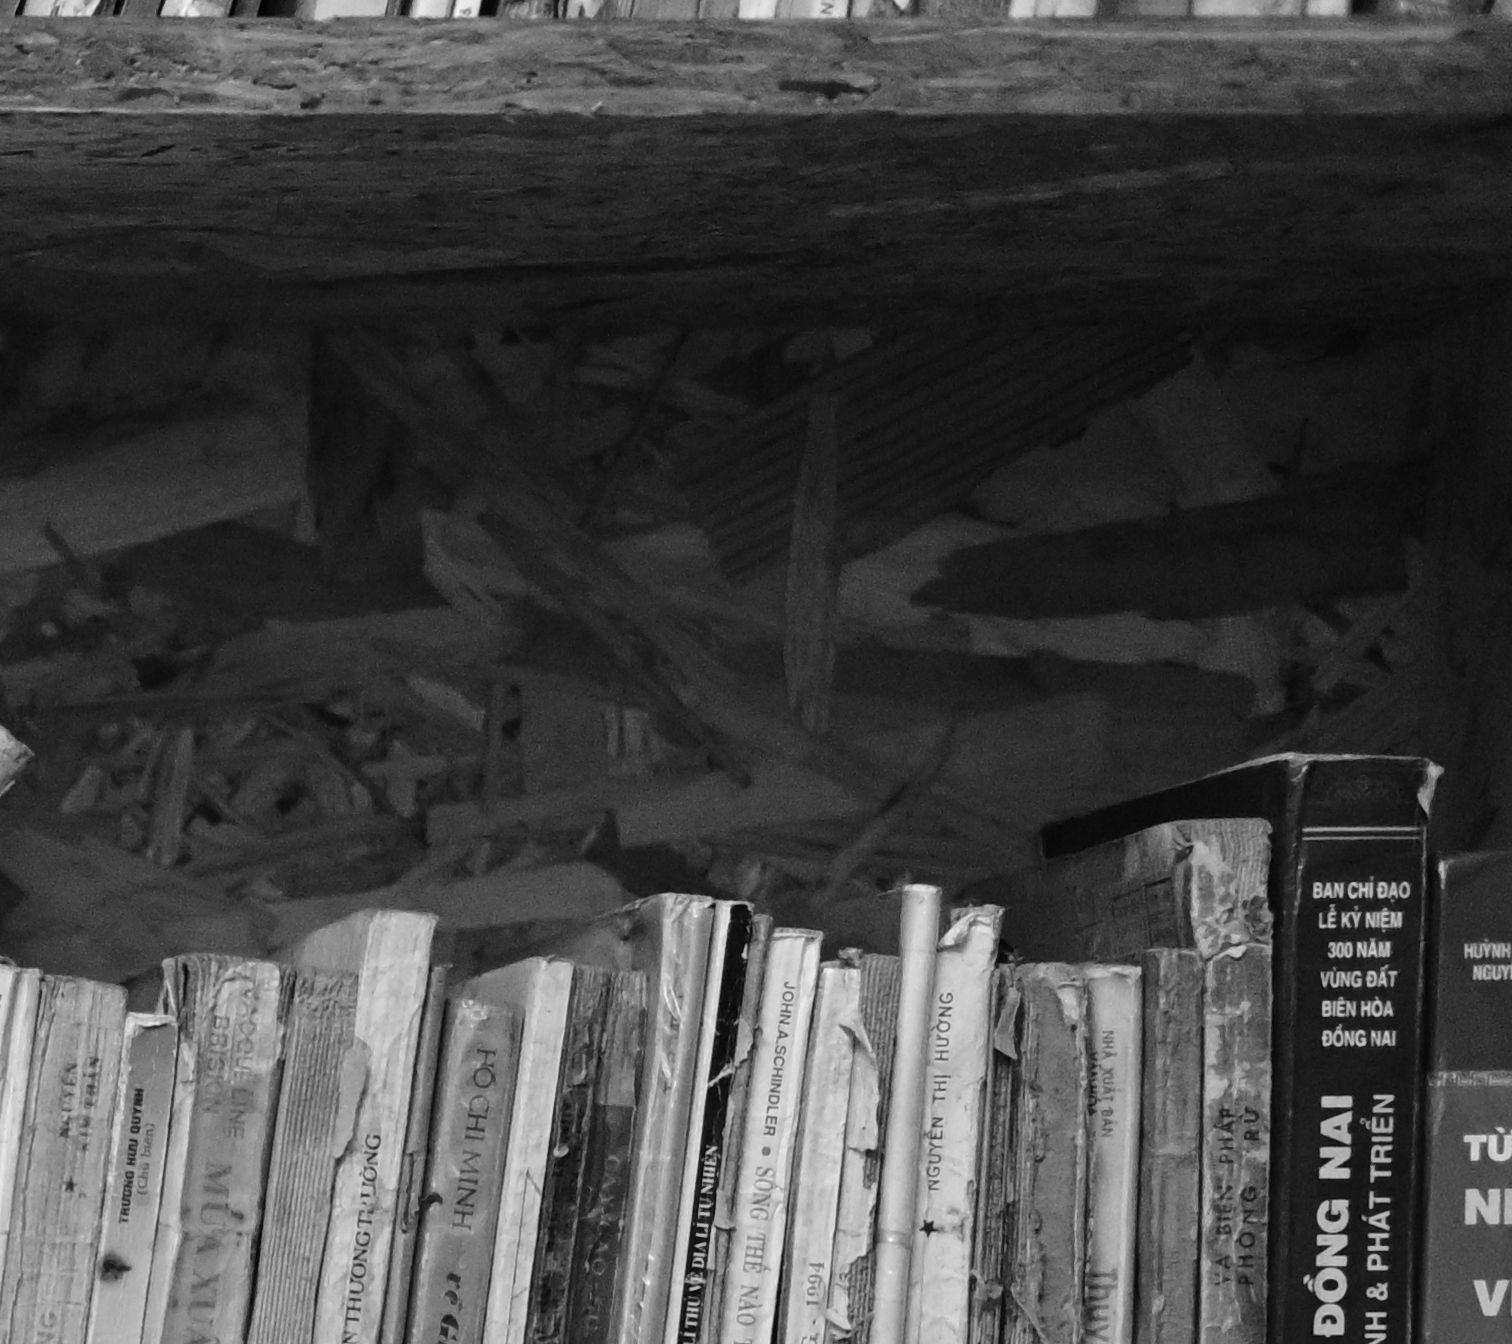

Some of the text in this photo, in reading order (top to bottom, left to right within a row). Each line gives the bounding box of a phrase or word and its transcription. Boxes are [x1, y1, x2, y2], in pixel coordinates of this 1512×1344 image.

[1313, 877, 1411, 903] BAN CHỈ ĐẠO
[1318, 904, 1403, 932] LỄ KỶ NIỆM
[1328, 937, 1392, 958] 300 NĂM
[1320, 964, 1398, 988] VÙNG ĐẤT
[1321, 996, 1394, 1018] BIÊN HÒA
[1321, 1024, 1396, 1047] ĐỒNG NAI
[1319, 1095, 1353, 1179] NAI
[1303, 1199, 1349, 1337] ĐỒNG
